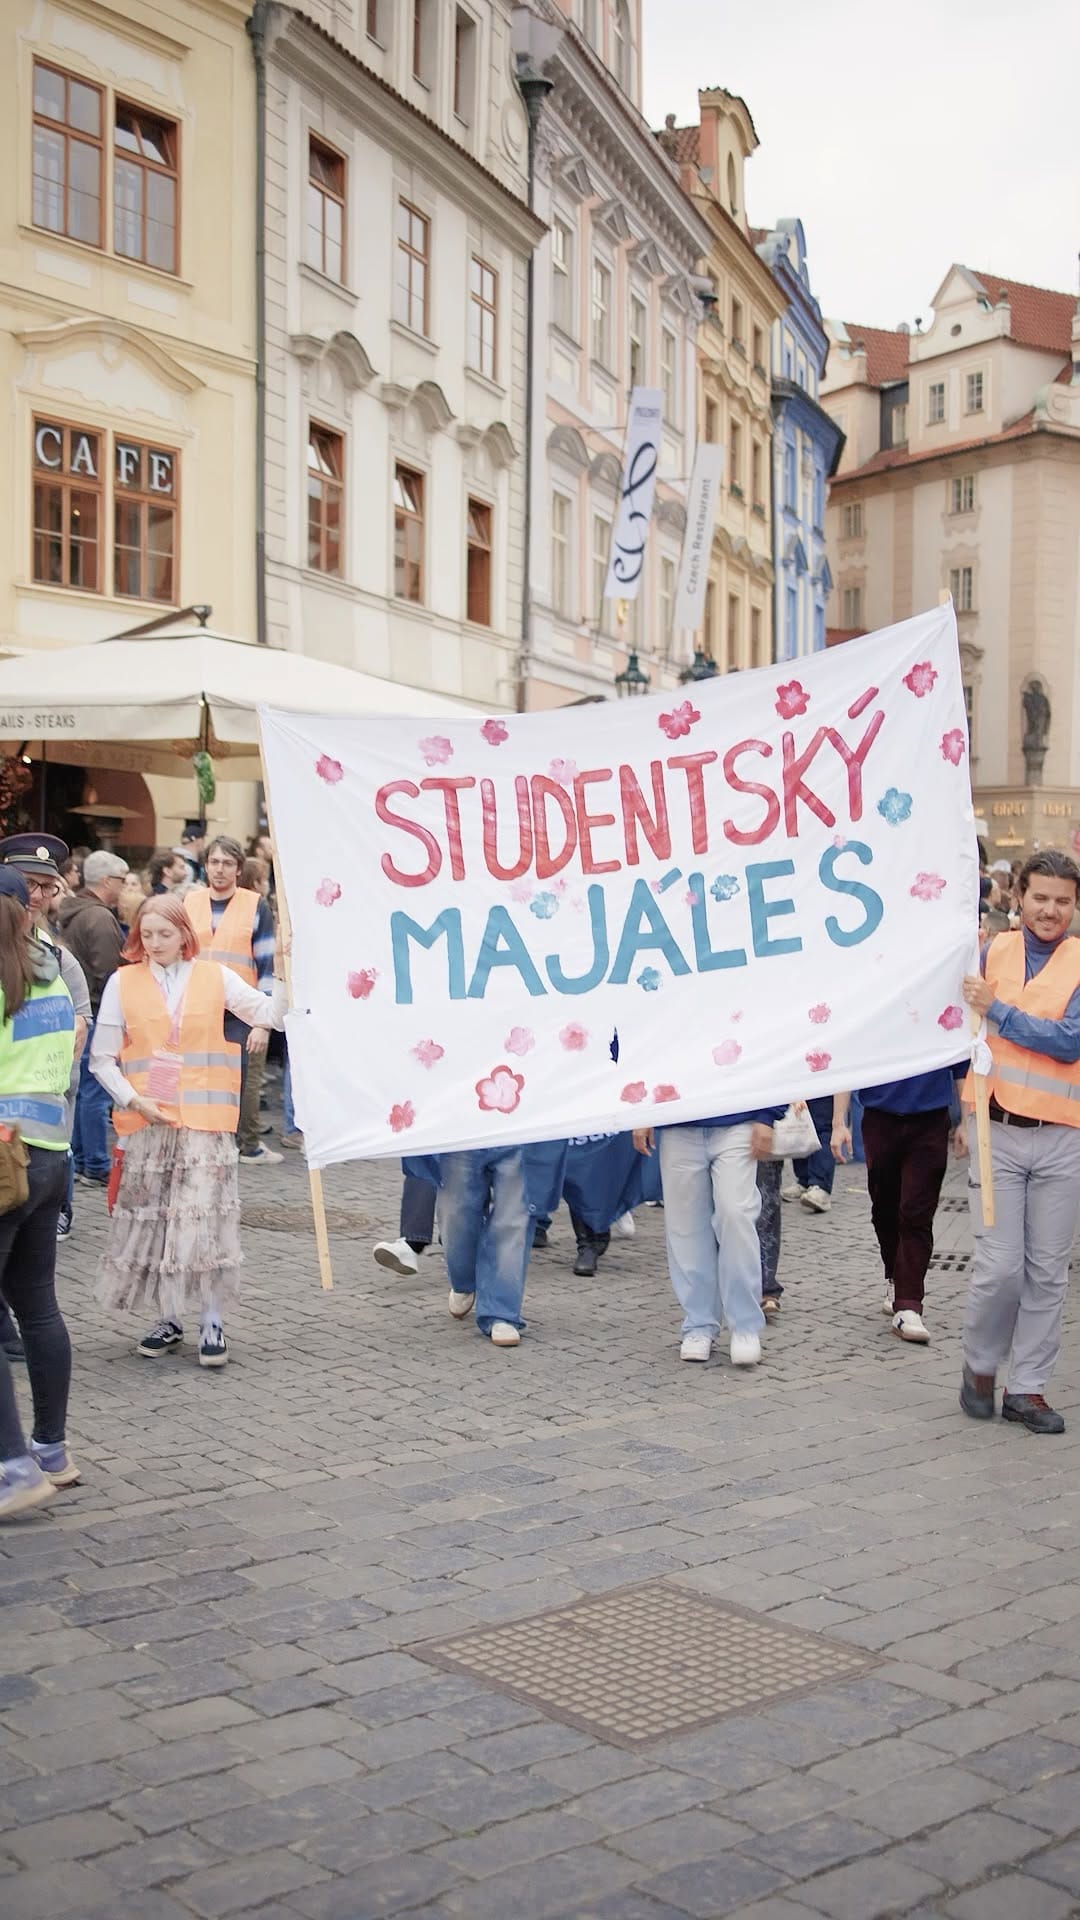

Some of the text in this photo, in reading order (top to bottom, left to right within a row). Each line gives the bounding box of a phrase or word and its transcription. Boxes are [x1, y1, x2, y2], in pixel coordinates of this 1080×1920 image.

[35, 427, 172, 493] CAFE
[686, 478, 712, 595] Czech Restaurant
[34, 714, 76, 728] STEAKS
[374, 686, 885, 888] STUDENTSKÝ
[390, 839, 885, 1005] MAJÁLES
